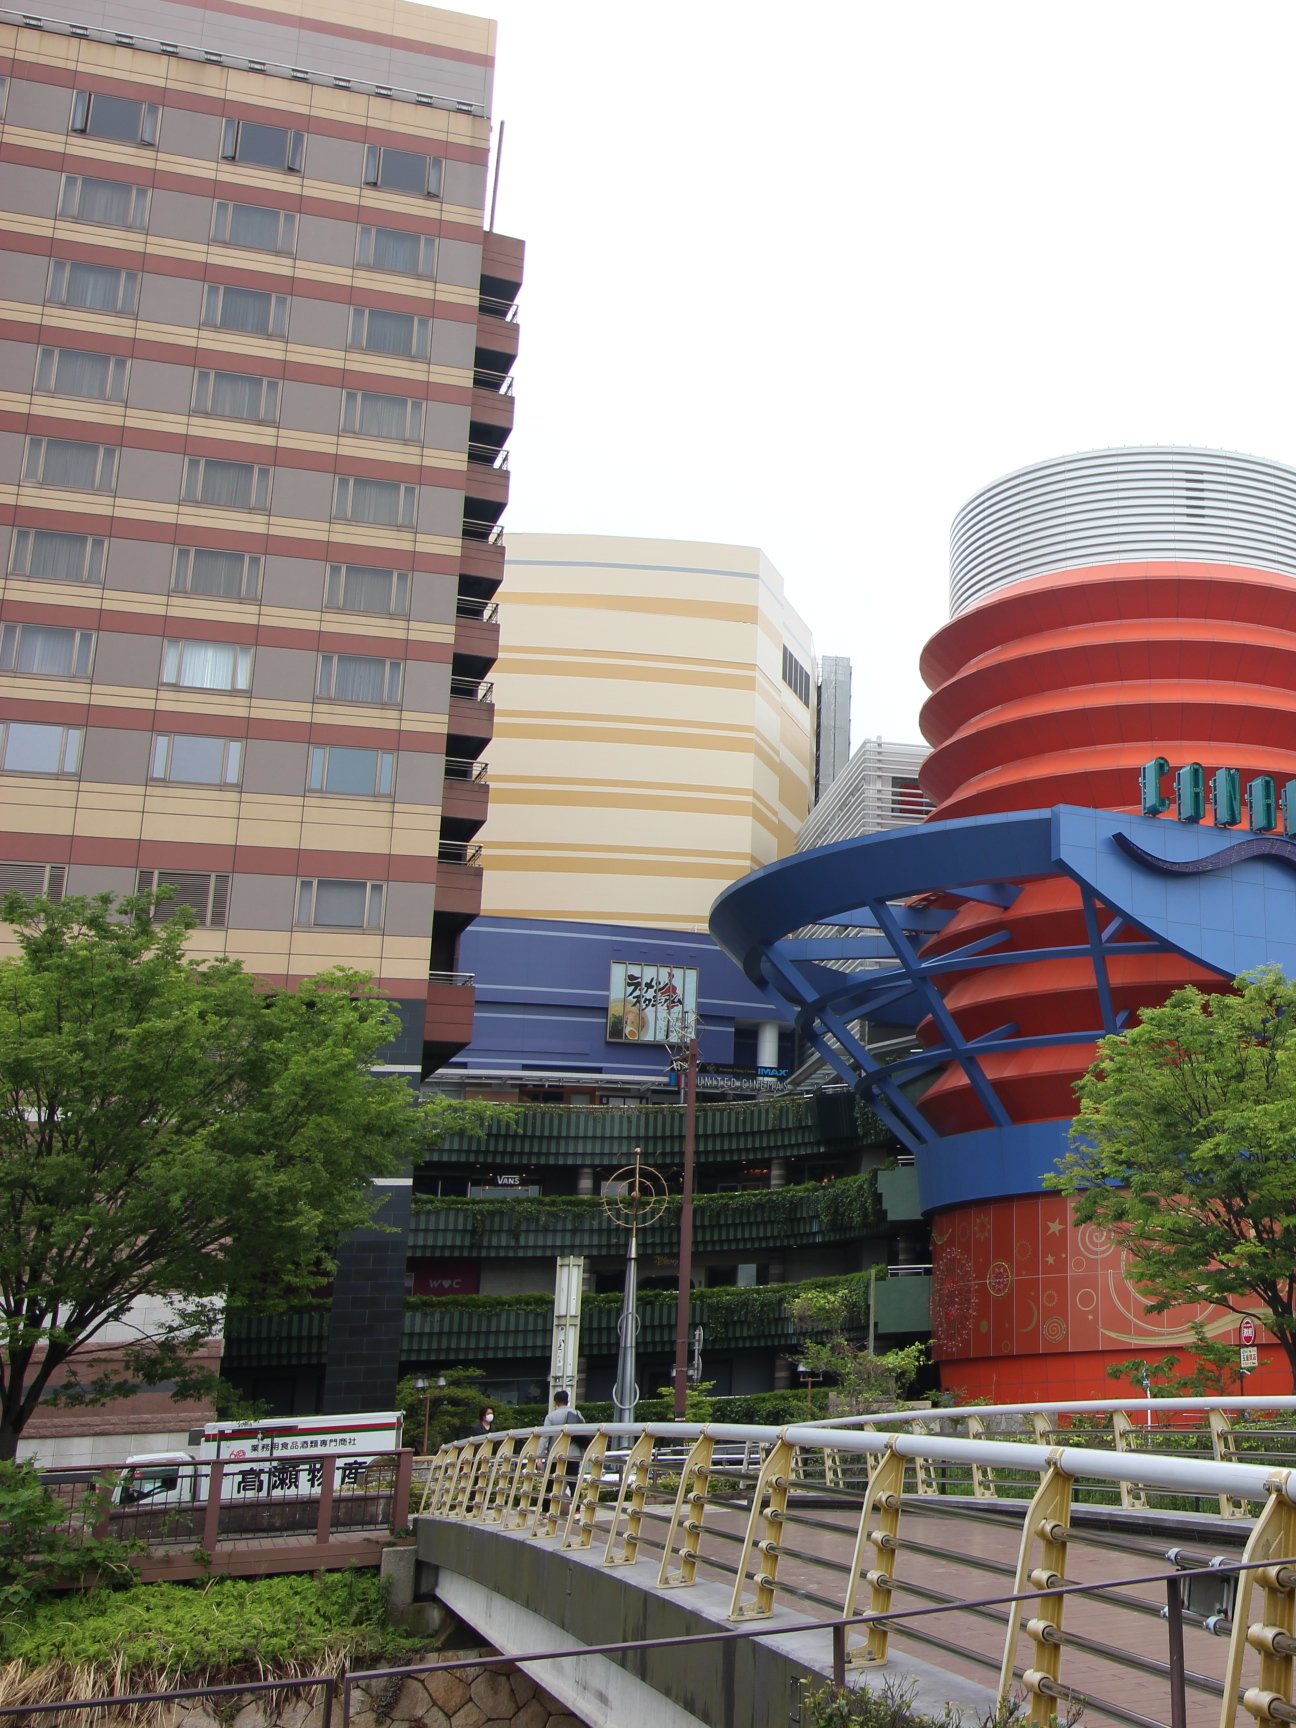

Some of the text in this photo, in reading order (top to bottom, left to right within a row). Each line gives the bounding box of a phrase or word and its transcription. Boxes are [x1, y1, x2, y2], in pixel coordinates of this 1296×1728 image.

[757, 1068, 789, 1077] IMAX
[697, 1075, 736, 1089] UNITED
[497, 1175, 520, 1185] VANS
